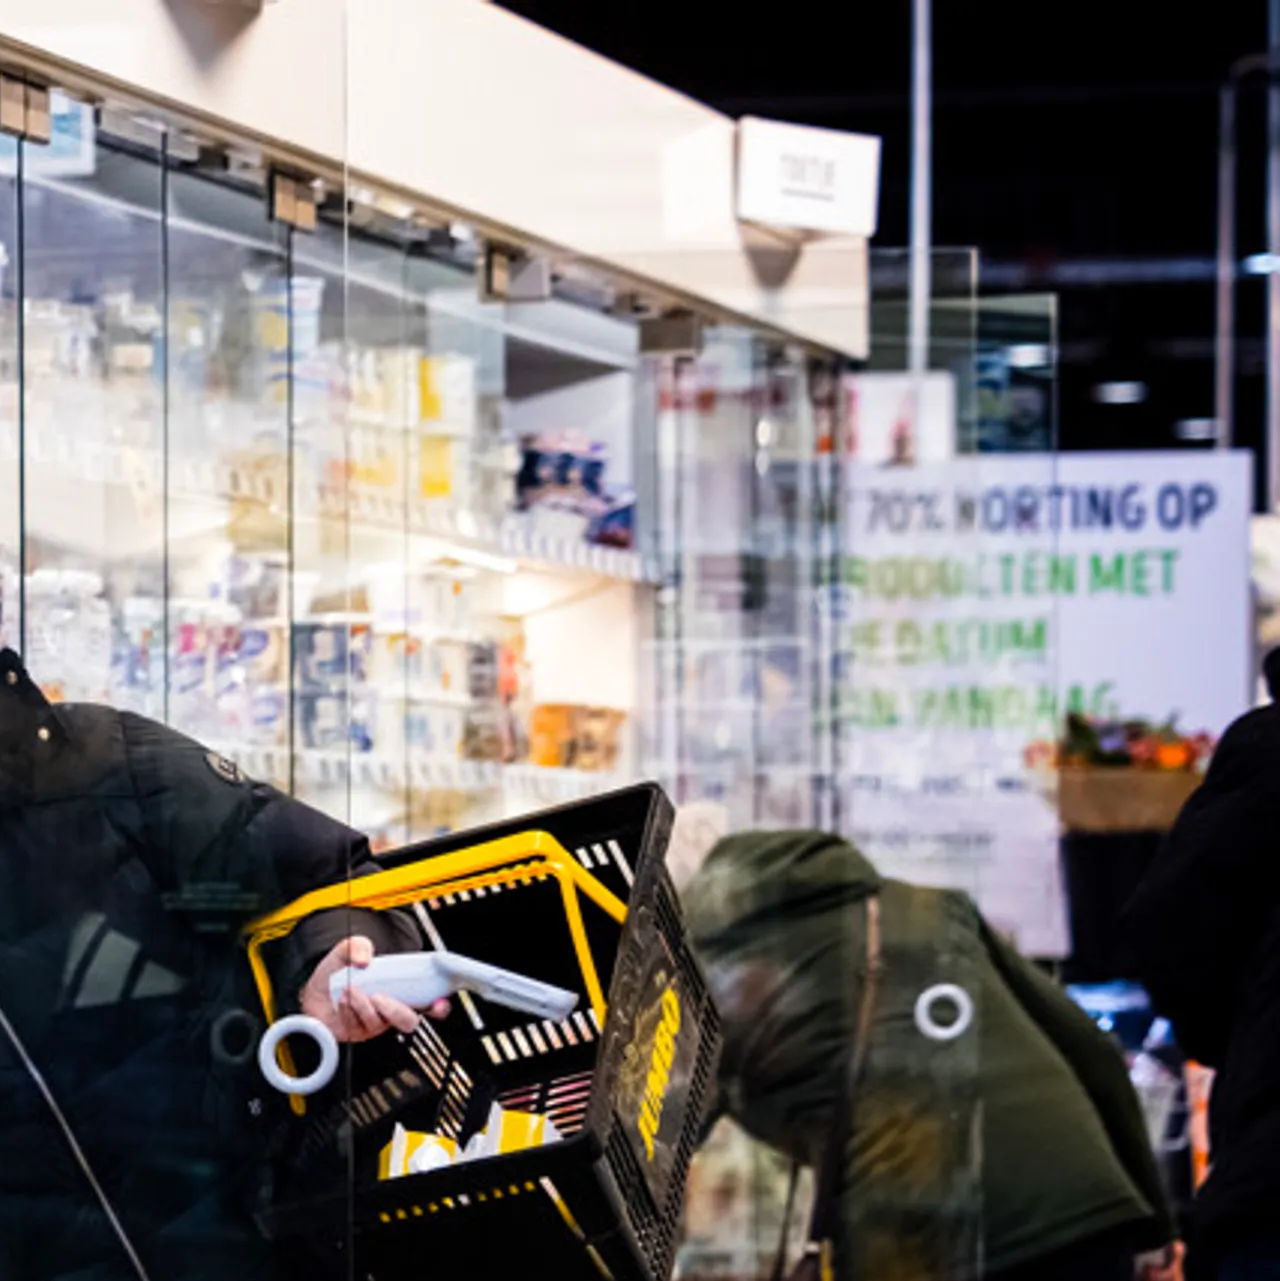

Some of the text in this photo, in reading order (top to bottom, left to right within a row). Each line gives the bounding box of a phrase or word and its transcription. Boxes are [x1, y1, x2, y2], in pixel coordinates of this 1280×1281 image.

[1156, 481, 1220, 530] OP
[1087, 548, 1182, 596] MET
[638, 985, 681, 1164] JUMBO
